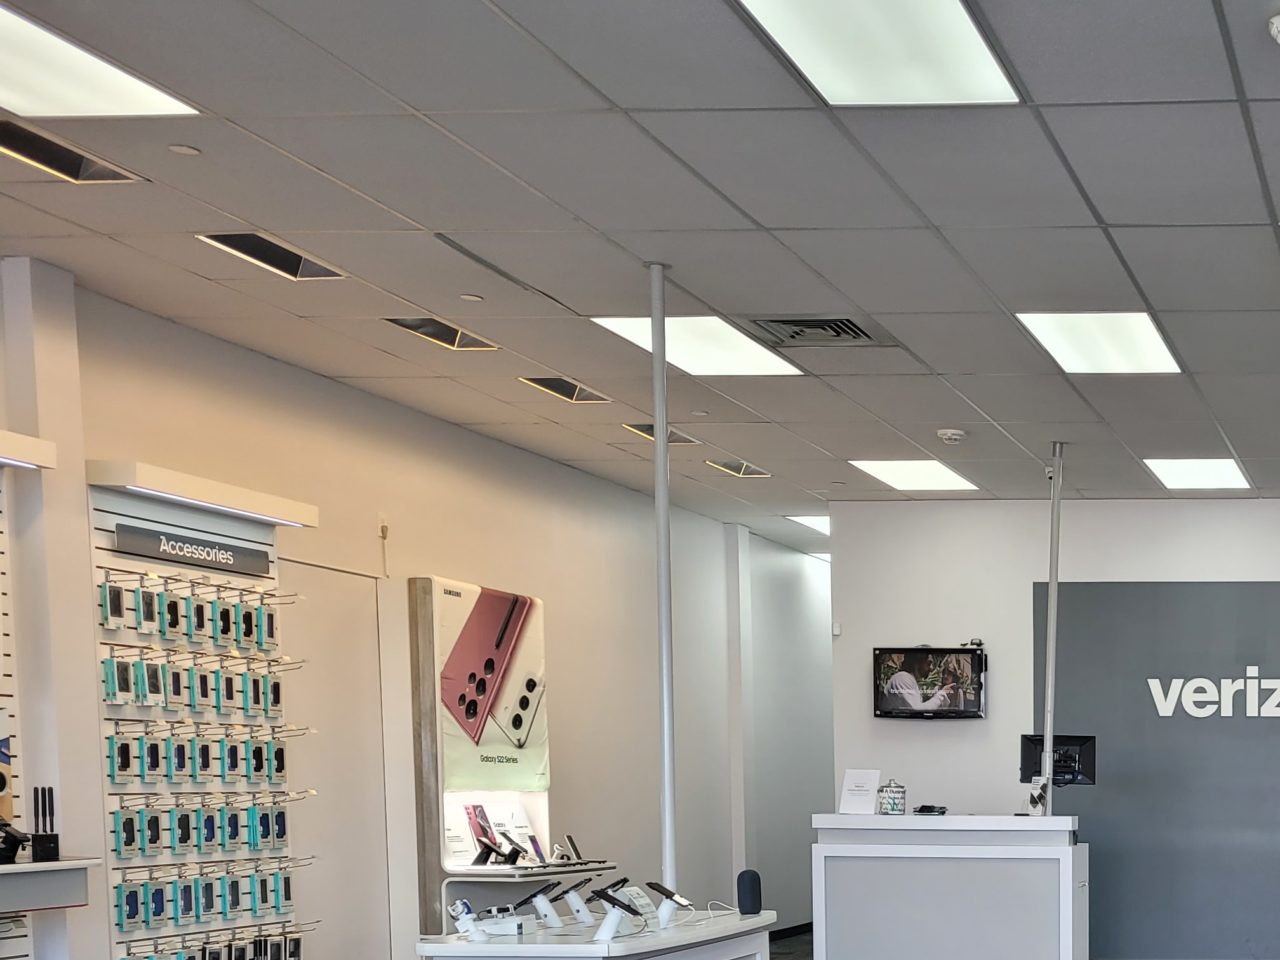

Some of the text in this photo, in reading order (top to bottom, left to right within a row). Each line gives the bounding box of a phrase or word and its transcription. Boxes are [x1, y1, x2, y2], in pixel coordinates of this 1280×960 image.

[159, 535, 234, 565] Accessories
[443, 588, 462, 598] SAMSUNG
[480, 754, 496, 764] Galaxy
[504, 755, 518, 764] Series
